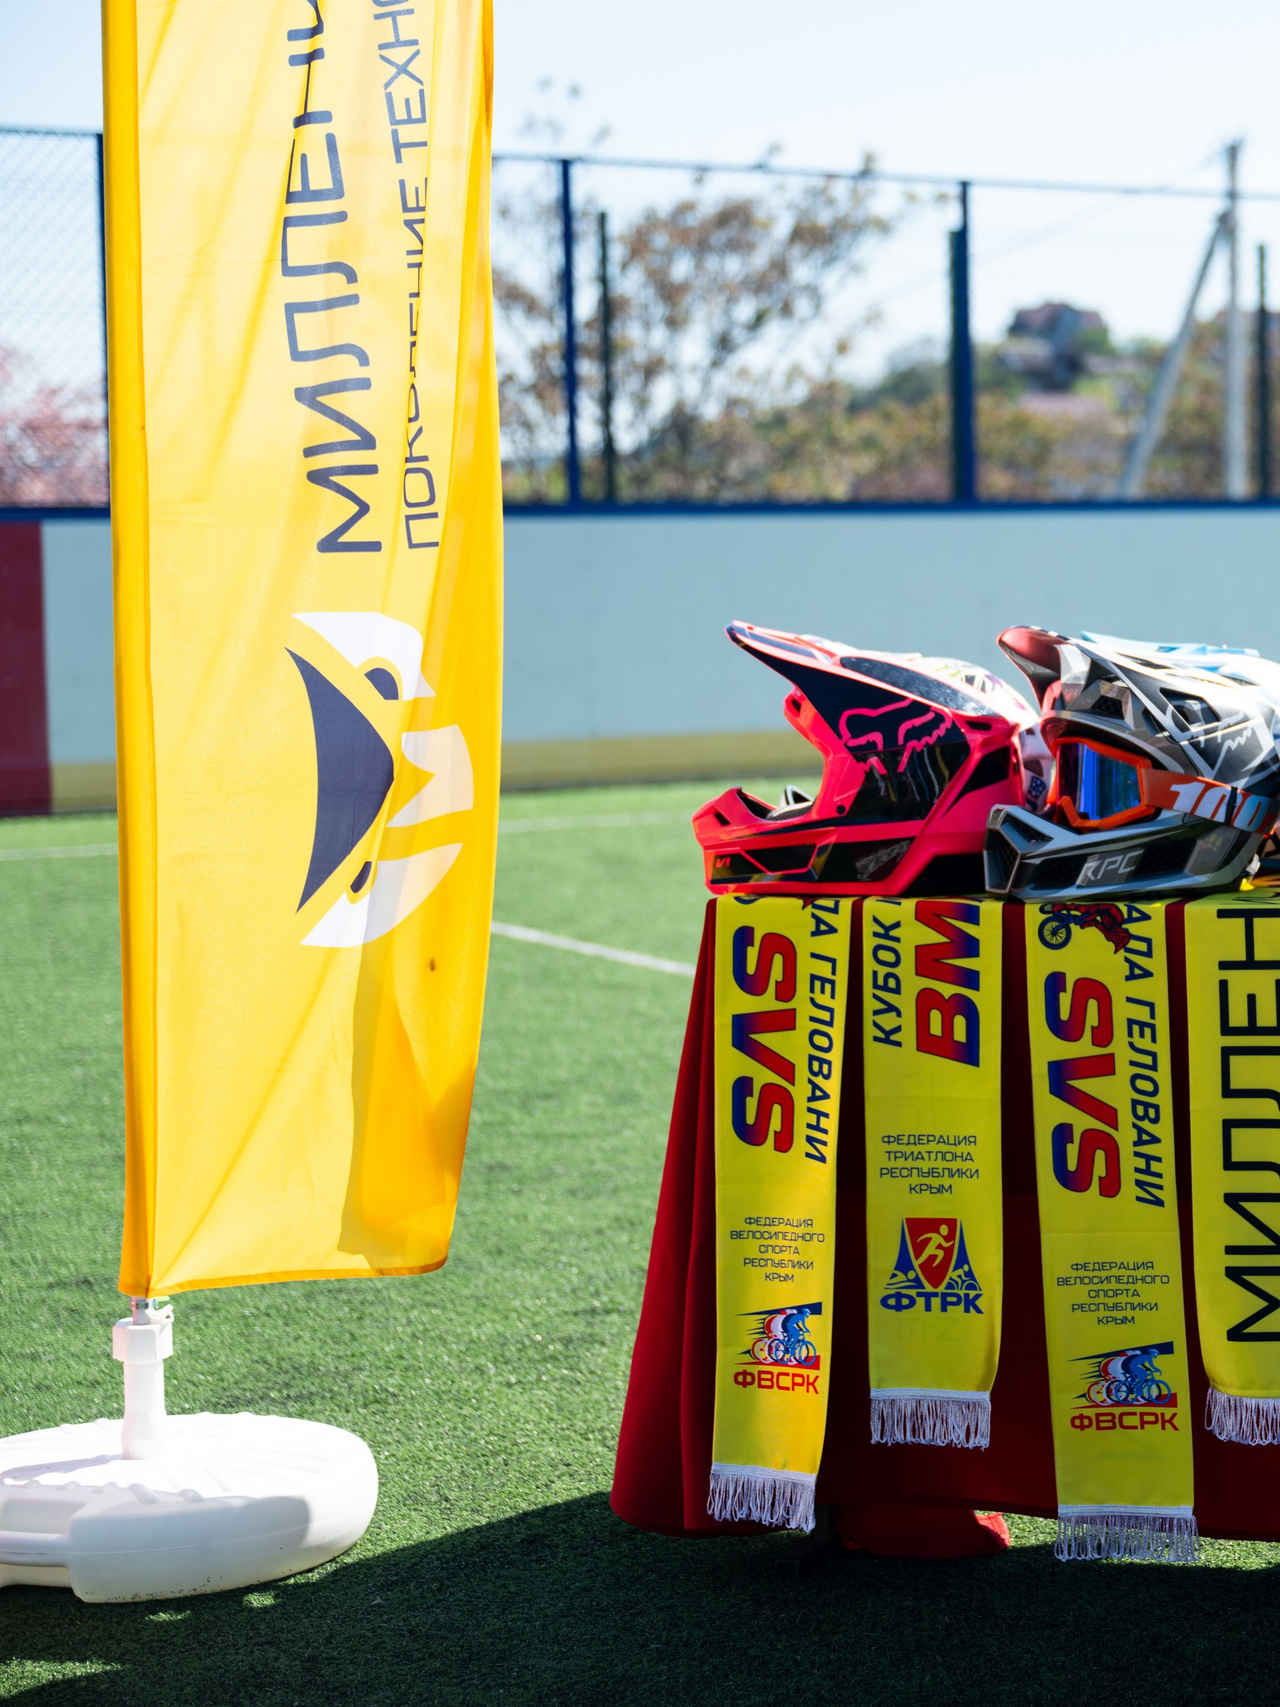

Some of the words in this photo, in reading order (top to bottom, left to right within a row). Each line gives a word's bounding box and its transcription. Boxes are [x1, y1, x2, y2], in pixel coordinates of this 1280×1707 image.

[372, 0, 427, 163] ТЕХН
[1170, 781, 1272, 832] 100
[1081, 849, 1141, 881] RPC
[872, 915, 902, 1047] КУБОК
[732, 926, 797, 1153] SVS
[805, 952, 837, 1164] ГЕЛОВАНИ
[1044, 972, 1121, 1198] SVS
[1126, 997, 1165, 1207] ГЕЛОВАНИ
[882, 1134, 976, 1146] ФЕДЕРАЦИЯ
[885, 1151, 974, 1162] ТРИАТЛОНА
[880, 1167, 979, 1178] РЕСПУБЛИКИ
[910, 1184, 952, 1194] КРЫМ
[744, 1217, 813, 1228] ФЕДЕРАЦИЯ
[730, 1230, 824, 1242] ВЕЛОСИПЕДНОГО
[759, 1244, 800, 1255] СПОРТА
[743, 1258, 813, 1269] РЕСПУБЛИКИ
[1071, 1262, 1154, 1272] ФЕДЕРАЦИЯ
[765, 1273, 794, 1282] КРЫМ
[1057, 1275, 1169, 1286] ВЕЛОСИПЕДНОГО
[1088, 1289, 1140, 1298] СПОРТА
[880, 1292, 983, 1314] ФТРК
[1072, 1302, 1158, 1312] РЕСПУБЛИКИ
[1097, 1316, 1134, 1325] КРЫМ
[734, 1369, 820, 1394] ФВСРК
[1071, 1412, 1179, 1431] ФВСРК
